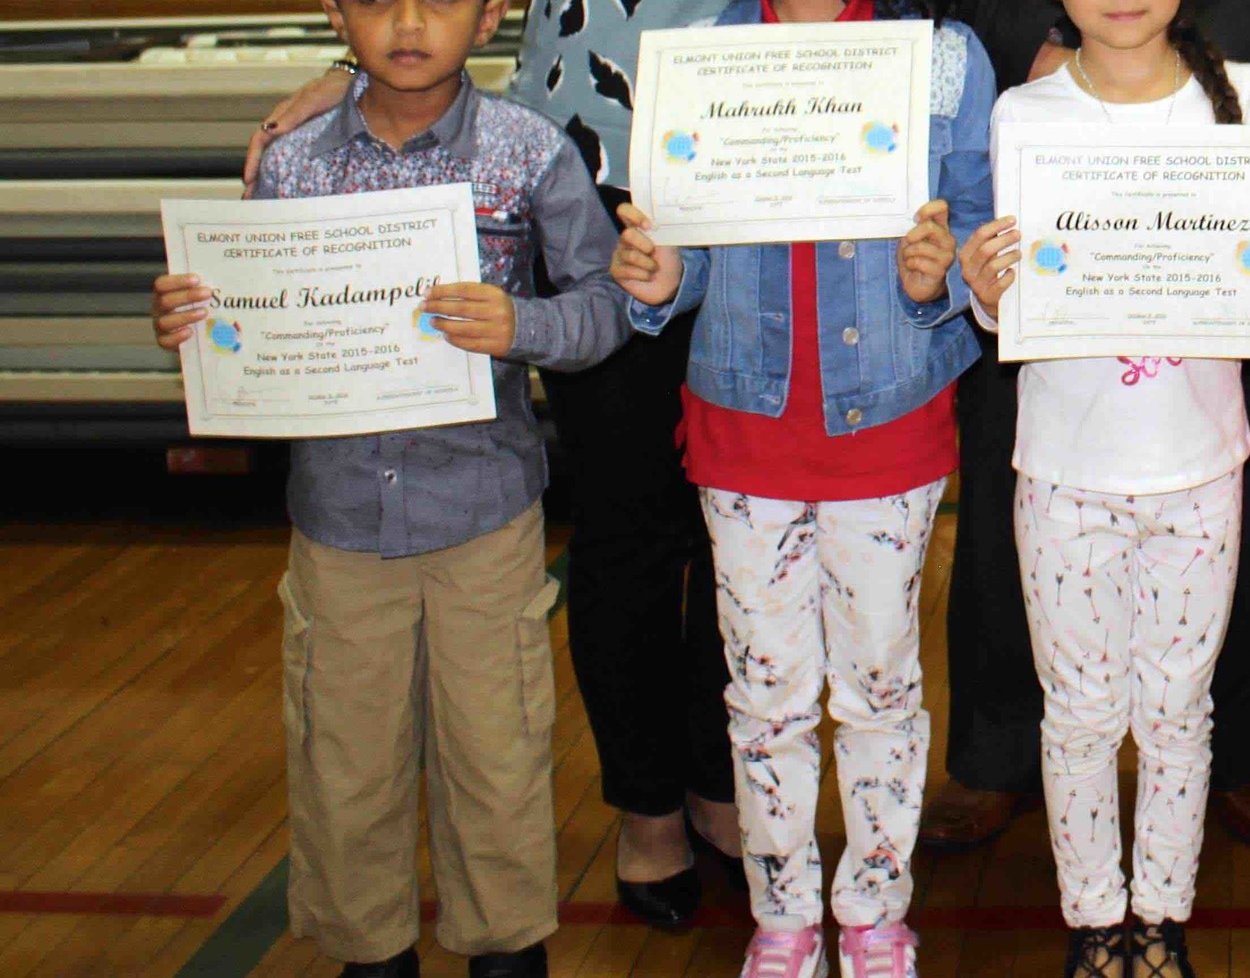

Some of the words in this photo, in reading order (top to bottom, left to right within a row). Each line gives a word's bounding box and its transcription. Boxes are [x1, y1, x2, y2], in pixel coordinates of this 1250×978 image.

[674, 53, 718, 64] ELMONT
[722, 51, 760, 61] UNION
[765, 50, 791, 60] FREE
[796, 48, 840, 59] SCHOOL
[844, 46, 898, 58] DISTRICT
[697, 64, 769, 76] CERTIFICATE
[773, 63, 786, 72] OF
[792, 61, 872, 72] RECOGNITION
[700, 100, 797, 119] Mahrukh
[804, 96, 864, 115] Khan
[1035, 156, 1083, 165] ELMONT
[1088, 156, 1129, 165] UNION
[1134, 155, 1161, 165] FREE
[1165, 155, 1212, 165] SCHOOL
[1062, 171, 1139, 181] CERTIFICATE
[1143, 171, 1157, 181] OF
[1163, 171, 1245, 181] RECOGNITION
[1056, 210, 1139, 231] Alisson
[1147, 211, 1250, 232] Martinez
[198, 232, 240, 243] ELMONT
[246, 232, 286, 242] UNION
[291, 230, 319, 241] FREE
[325, 226, 374, 239] SCHOOL
[378, 219, 437, 234] DISTRICT
[224, 247, 298, 258] CERTIFICATE
[303, 245, 318, 256] OF
[323, 237, 412, 254] RECOGNITION
[1083, 274, 1104, 282] New
[1108, 273, 1130, 282] York
[1134, 273, 1161, 283] State
[1166, 273, 1221, 282] 2015-2016
[209, 288, 289, 310] Samuel
[1066, 287, 1099, 297] English
[1129, 287, 1162, 296] Second
[1167, 287, 1210, 298] Language
[1216, 287, 1237, 296] Test
[257, 352, 277, 362] New
[282, 351, 304, 361] York
[309, 349, 336, 360] State
[342, 344, 400, 358] 2015-2016
[244, 365, 276, 377] English
[280, 367, 290, 375] as
[294, 366, 301, 374] a
[306, 363, 339, 374] Second
[345, 360, 390, 374] Language
[397, 356, 418, 367] Test
